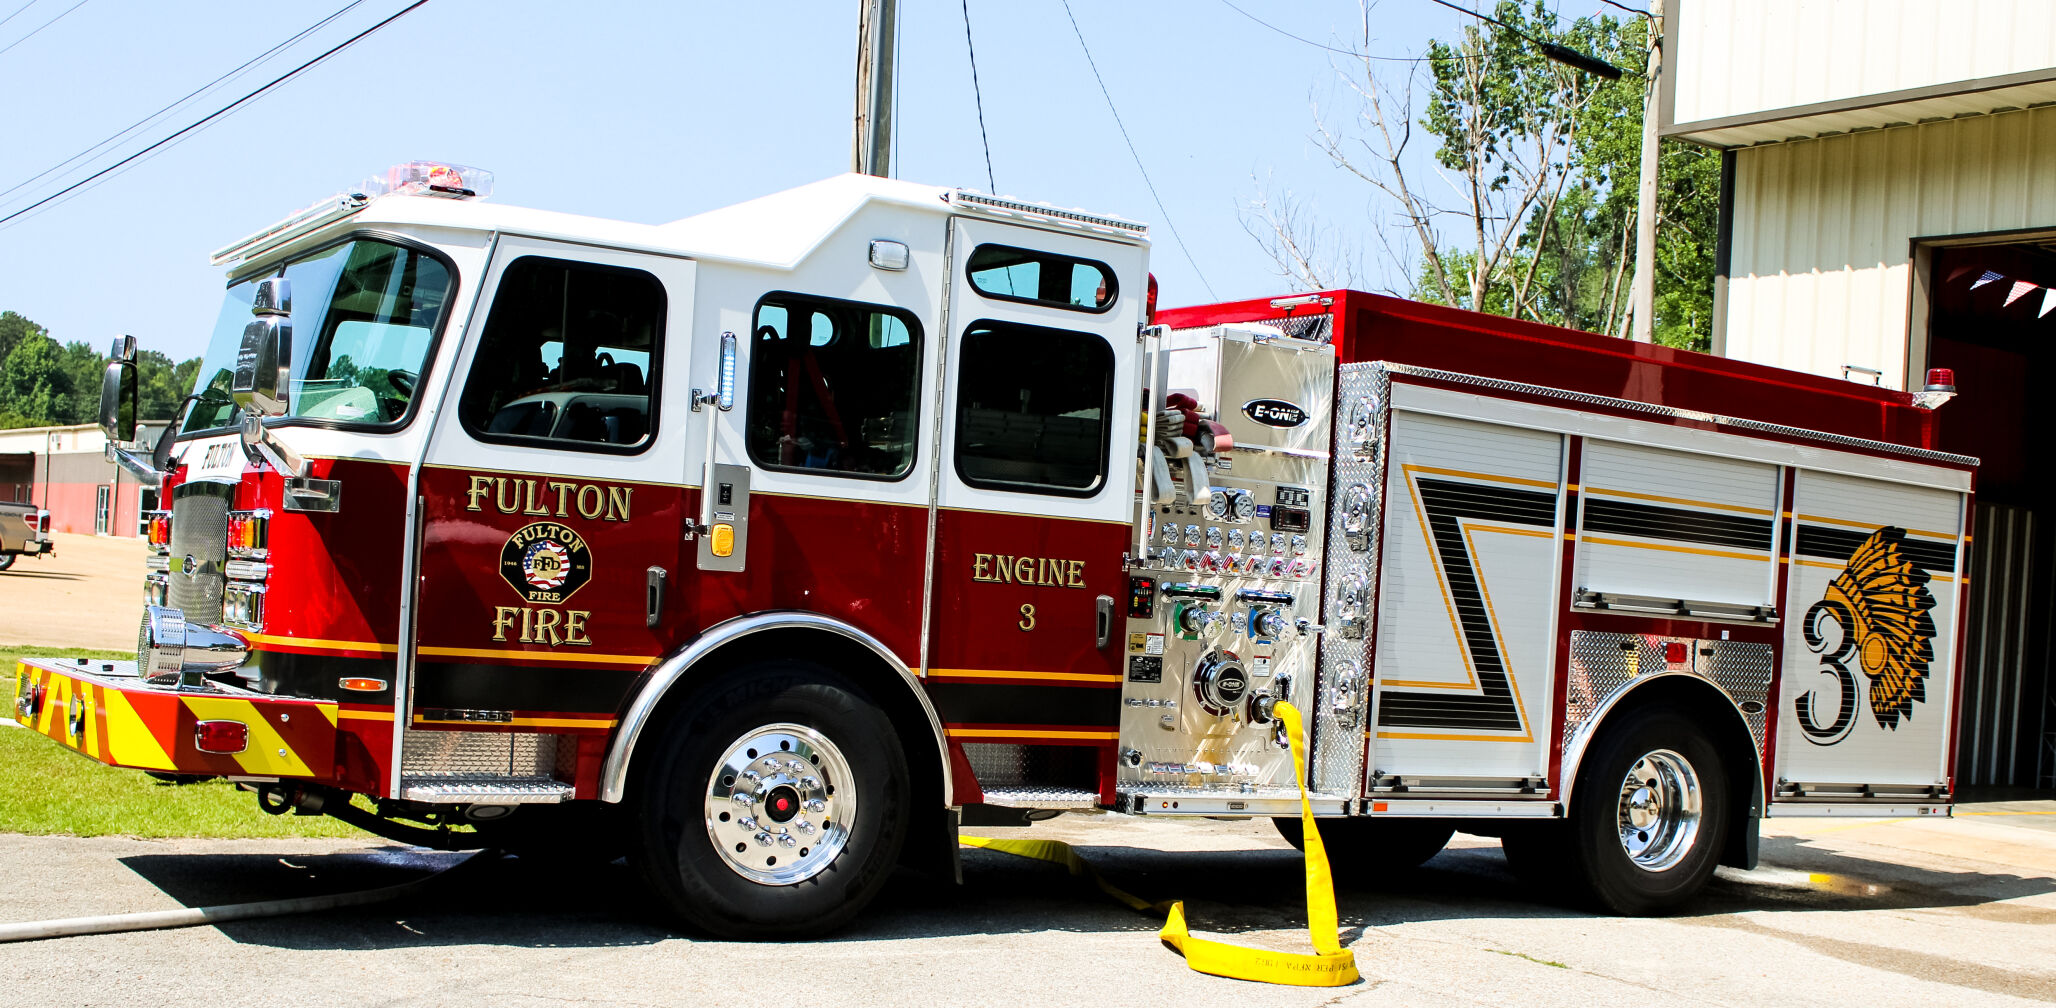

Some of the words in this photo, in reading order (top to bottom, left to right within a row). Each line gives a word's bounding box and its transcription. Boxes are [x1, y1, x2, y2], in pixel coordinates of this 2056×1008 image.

[1254, 404, 1300, 423] E-ONE
[202, 441, 239, 469] FULTON
[466, 475, 634, 522] FULTON
[511, 525, 584, 553] FULTON
[973, 553, 1087, 589] ENGINE
[528, 591, 561, 601] FIRE
[492, 606, 592, 646] FIRE
[1019, 603, 1037, 632] 3
[1795, 600, 1861, 746] 3
